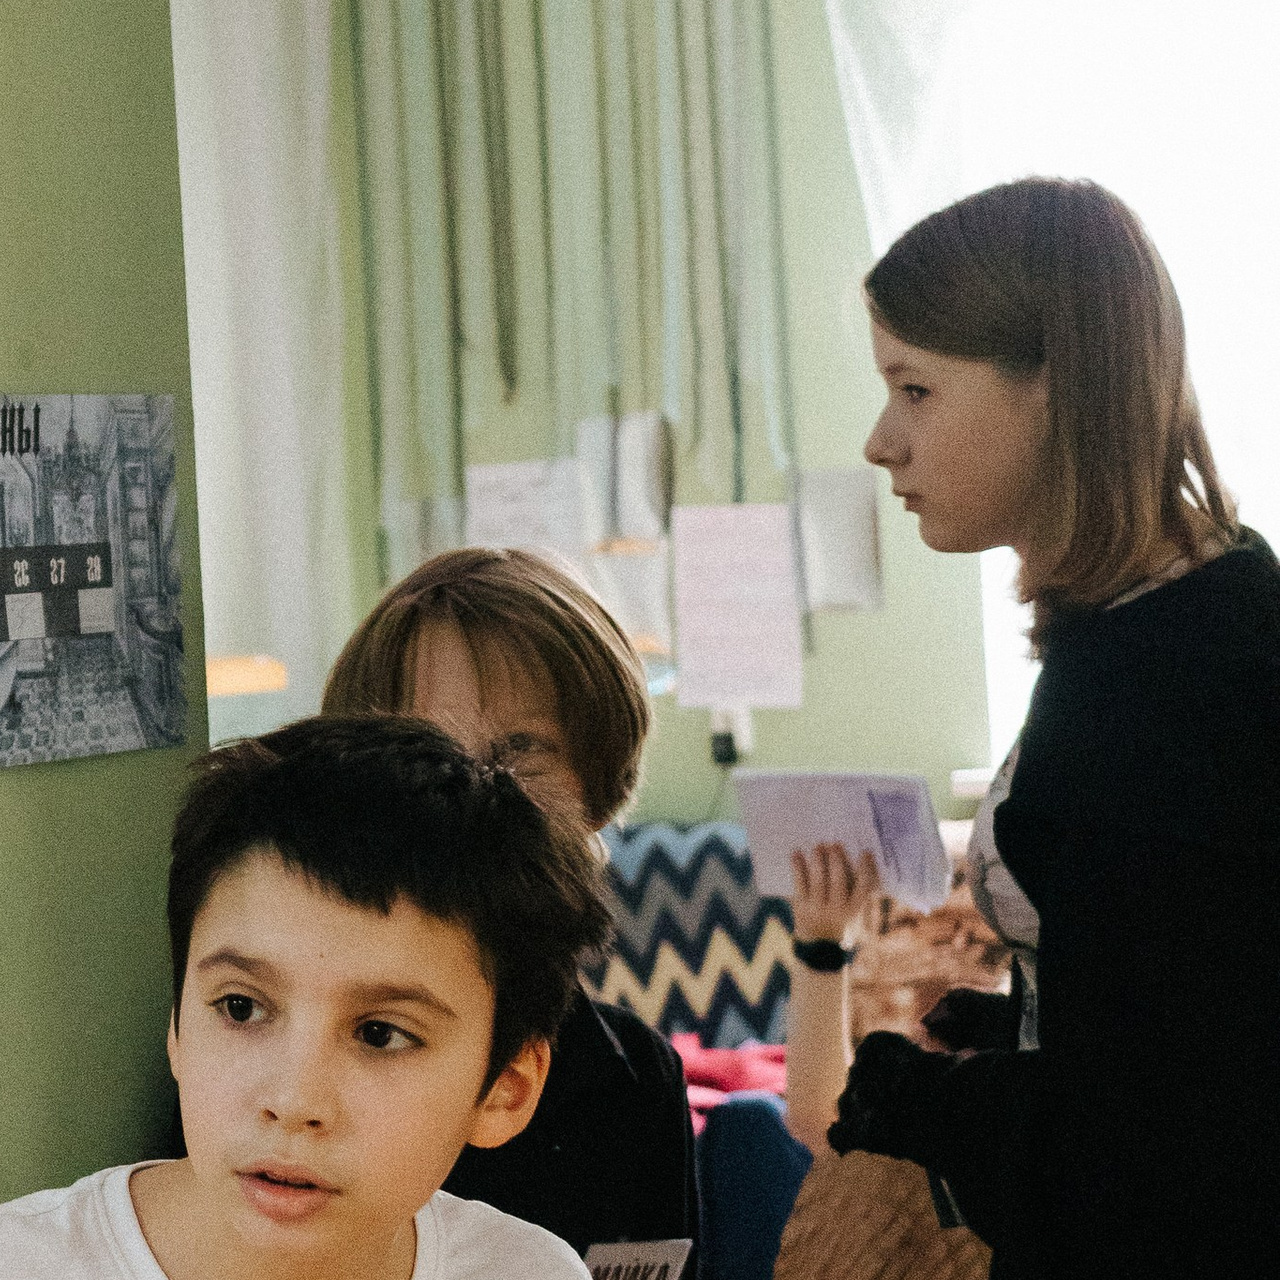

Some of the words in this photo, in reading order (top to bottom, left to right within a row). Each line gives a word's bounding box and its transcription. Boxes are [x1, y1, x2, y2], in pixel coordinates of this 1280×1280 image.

[13, 559, 30, 588] 26
[49, 557, 65, 585] 27
[86, 555, 102, 582] 28
